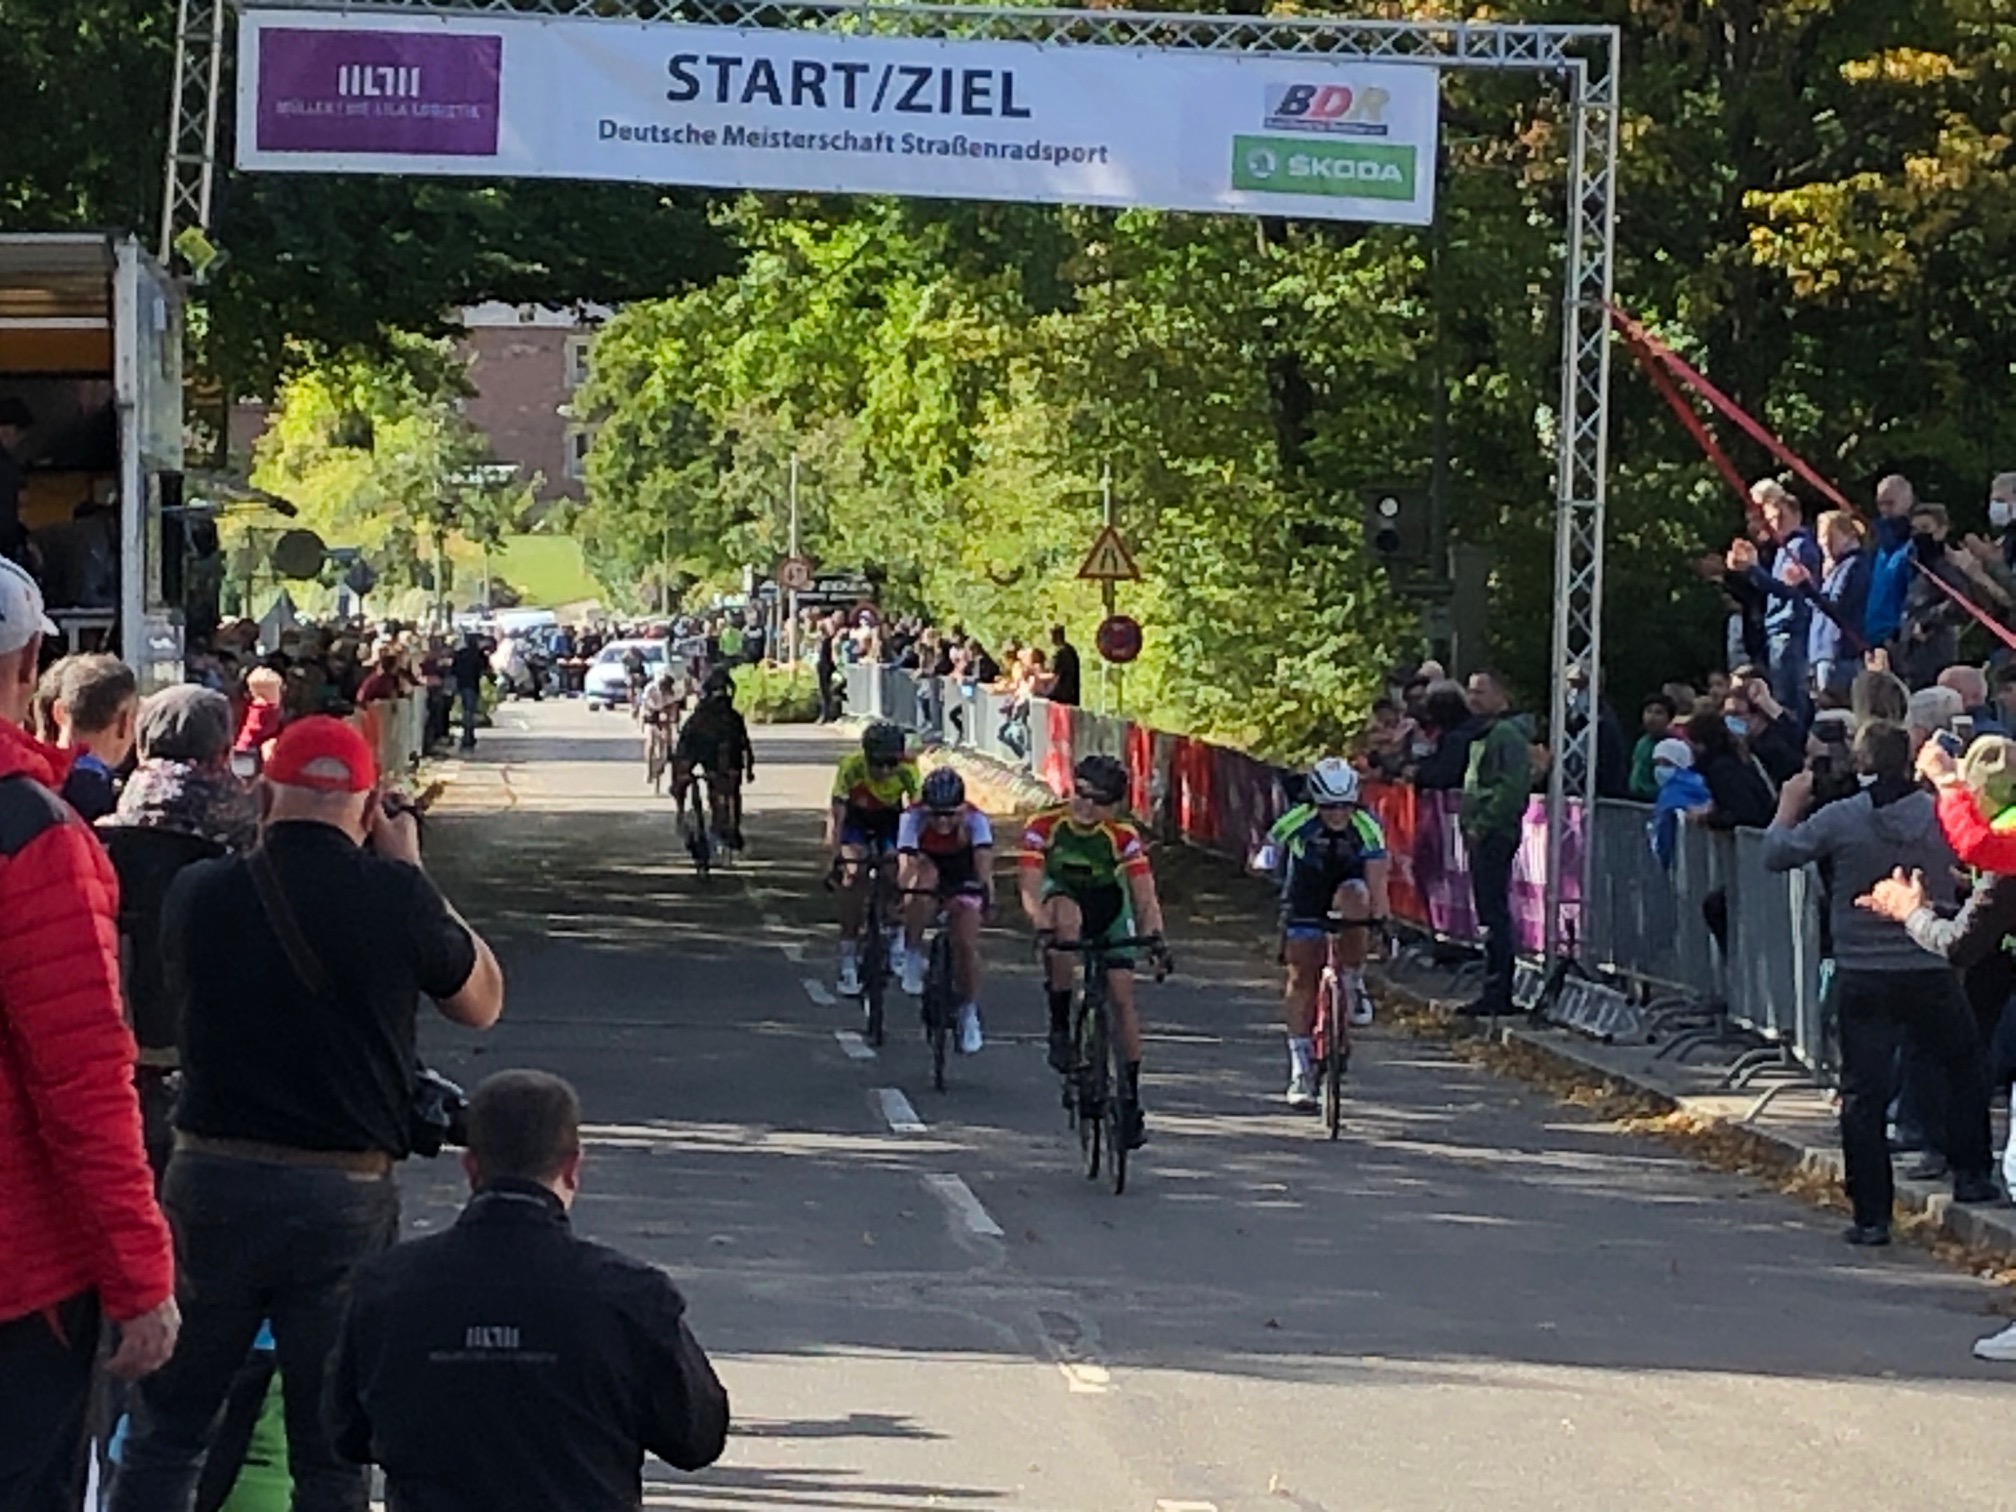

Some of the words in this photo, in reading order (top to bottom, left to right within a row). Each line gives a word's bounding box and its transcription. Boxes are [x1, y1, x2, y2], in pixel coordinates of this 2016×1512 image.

[666, 53, 1031, 118] START/ZIEL
[1274, 84, 1390, 123] BDR
[599, 119, 717, 146] Deutsche
[722, 124, 895, 153] Meisterschaft
[901, 132, 1108, 166] Straßenradsport
